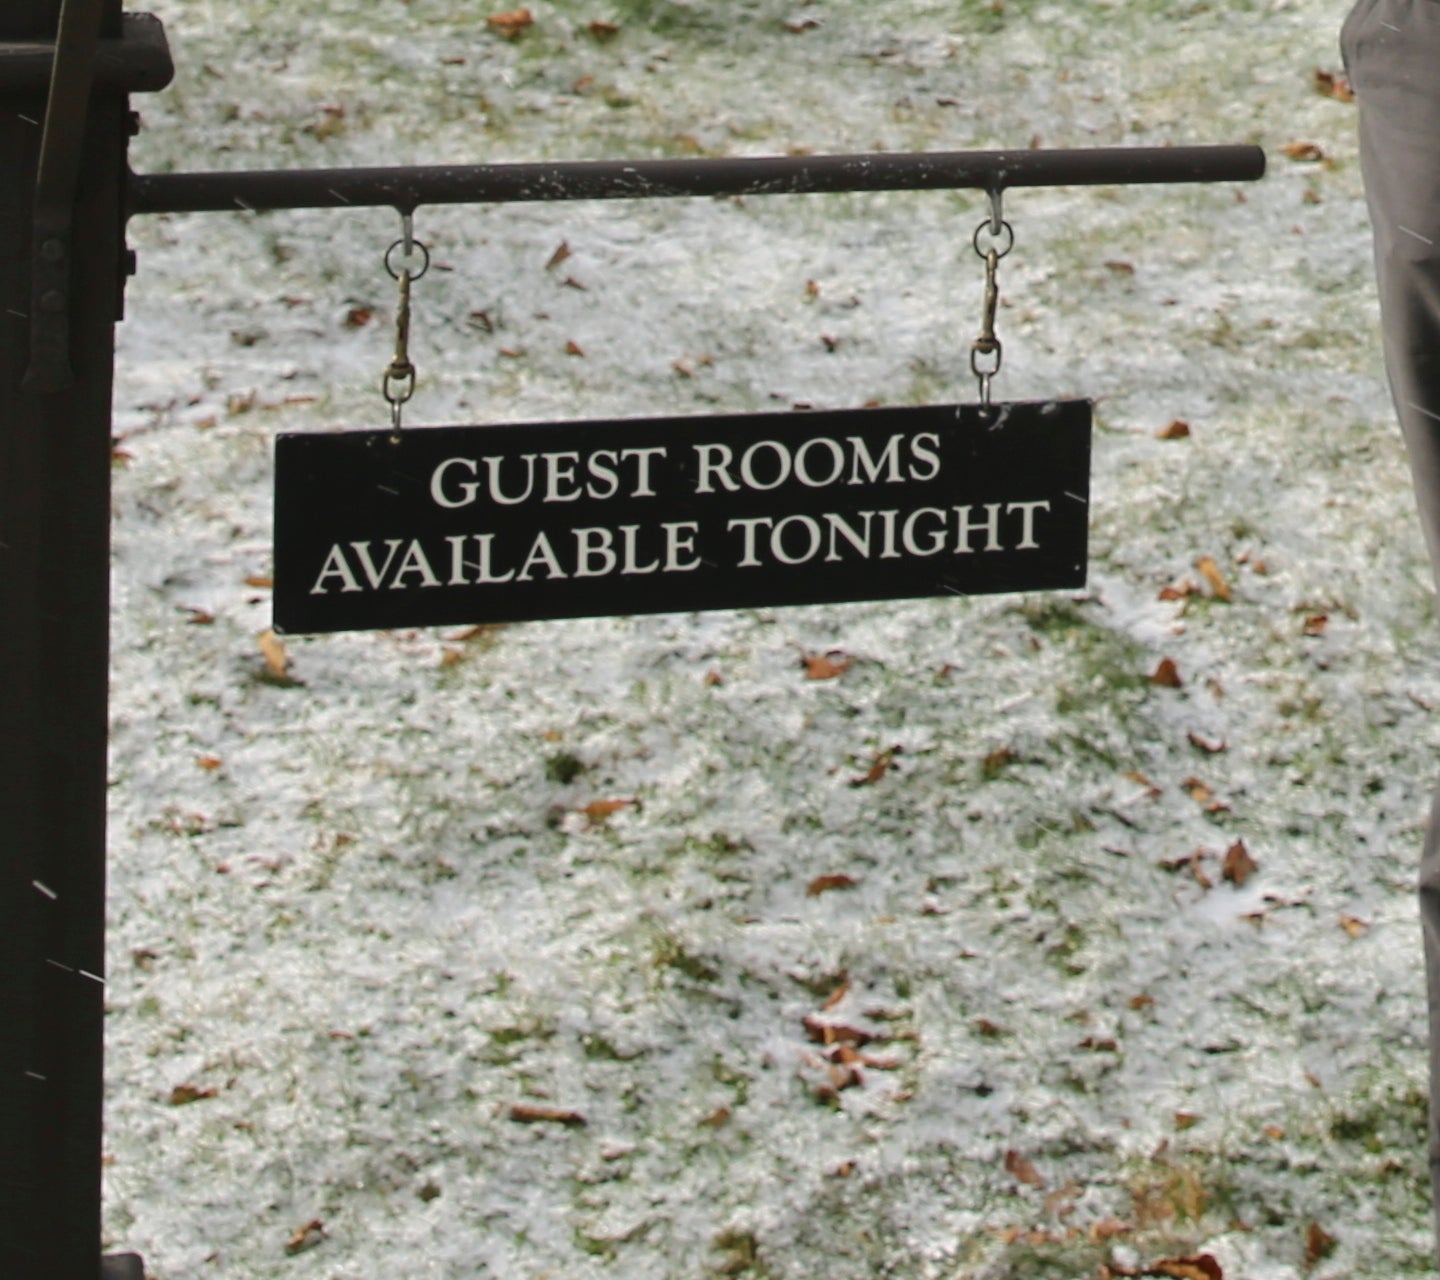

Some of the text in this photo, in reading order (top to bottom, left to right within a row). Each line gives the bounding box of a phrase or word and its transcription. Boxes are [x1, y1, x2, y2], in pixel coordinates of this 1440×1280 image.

[430, 432, 940, 508] GUEST ROOMS
[310, 500, 1050, 595] AVAILABLE TONIGHT
